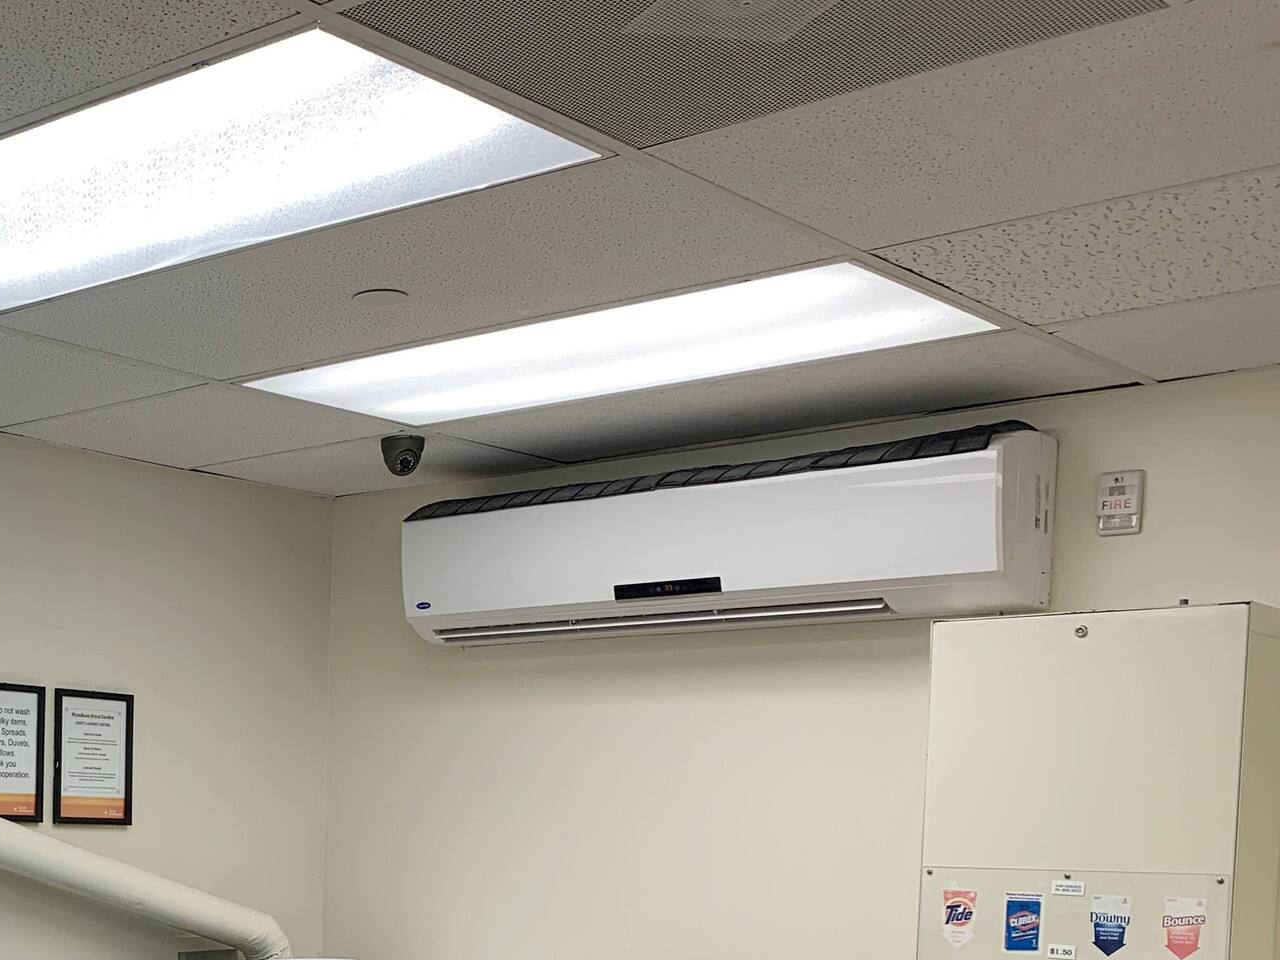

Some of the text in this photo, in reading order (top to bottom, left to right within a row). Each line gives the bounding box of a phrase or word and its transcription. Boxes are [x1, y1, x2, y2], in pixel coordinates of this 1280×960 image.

[1102, 498, 1132, 510] FIRE
[5, 761, 16, 769] you
[945, 904, 973, 924] Tide
[1090, 912, 1130, 926] Downy
[1163, 915, 1205, 927] Bounce
